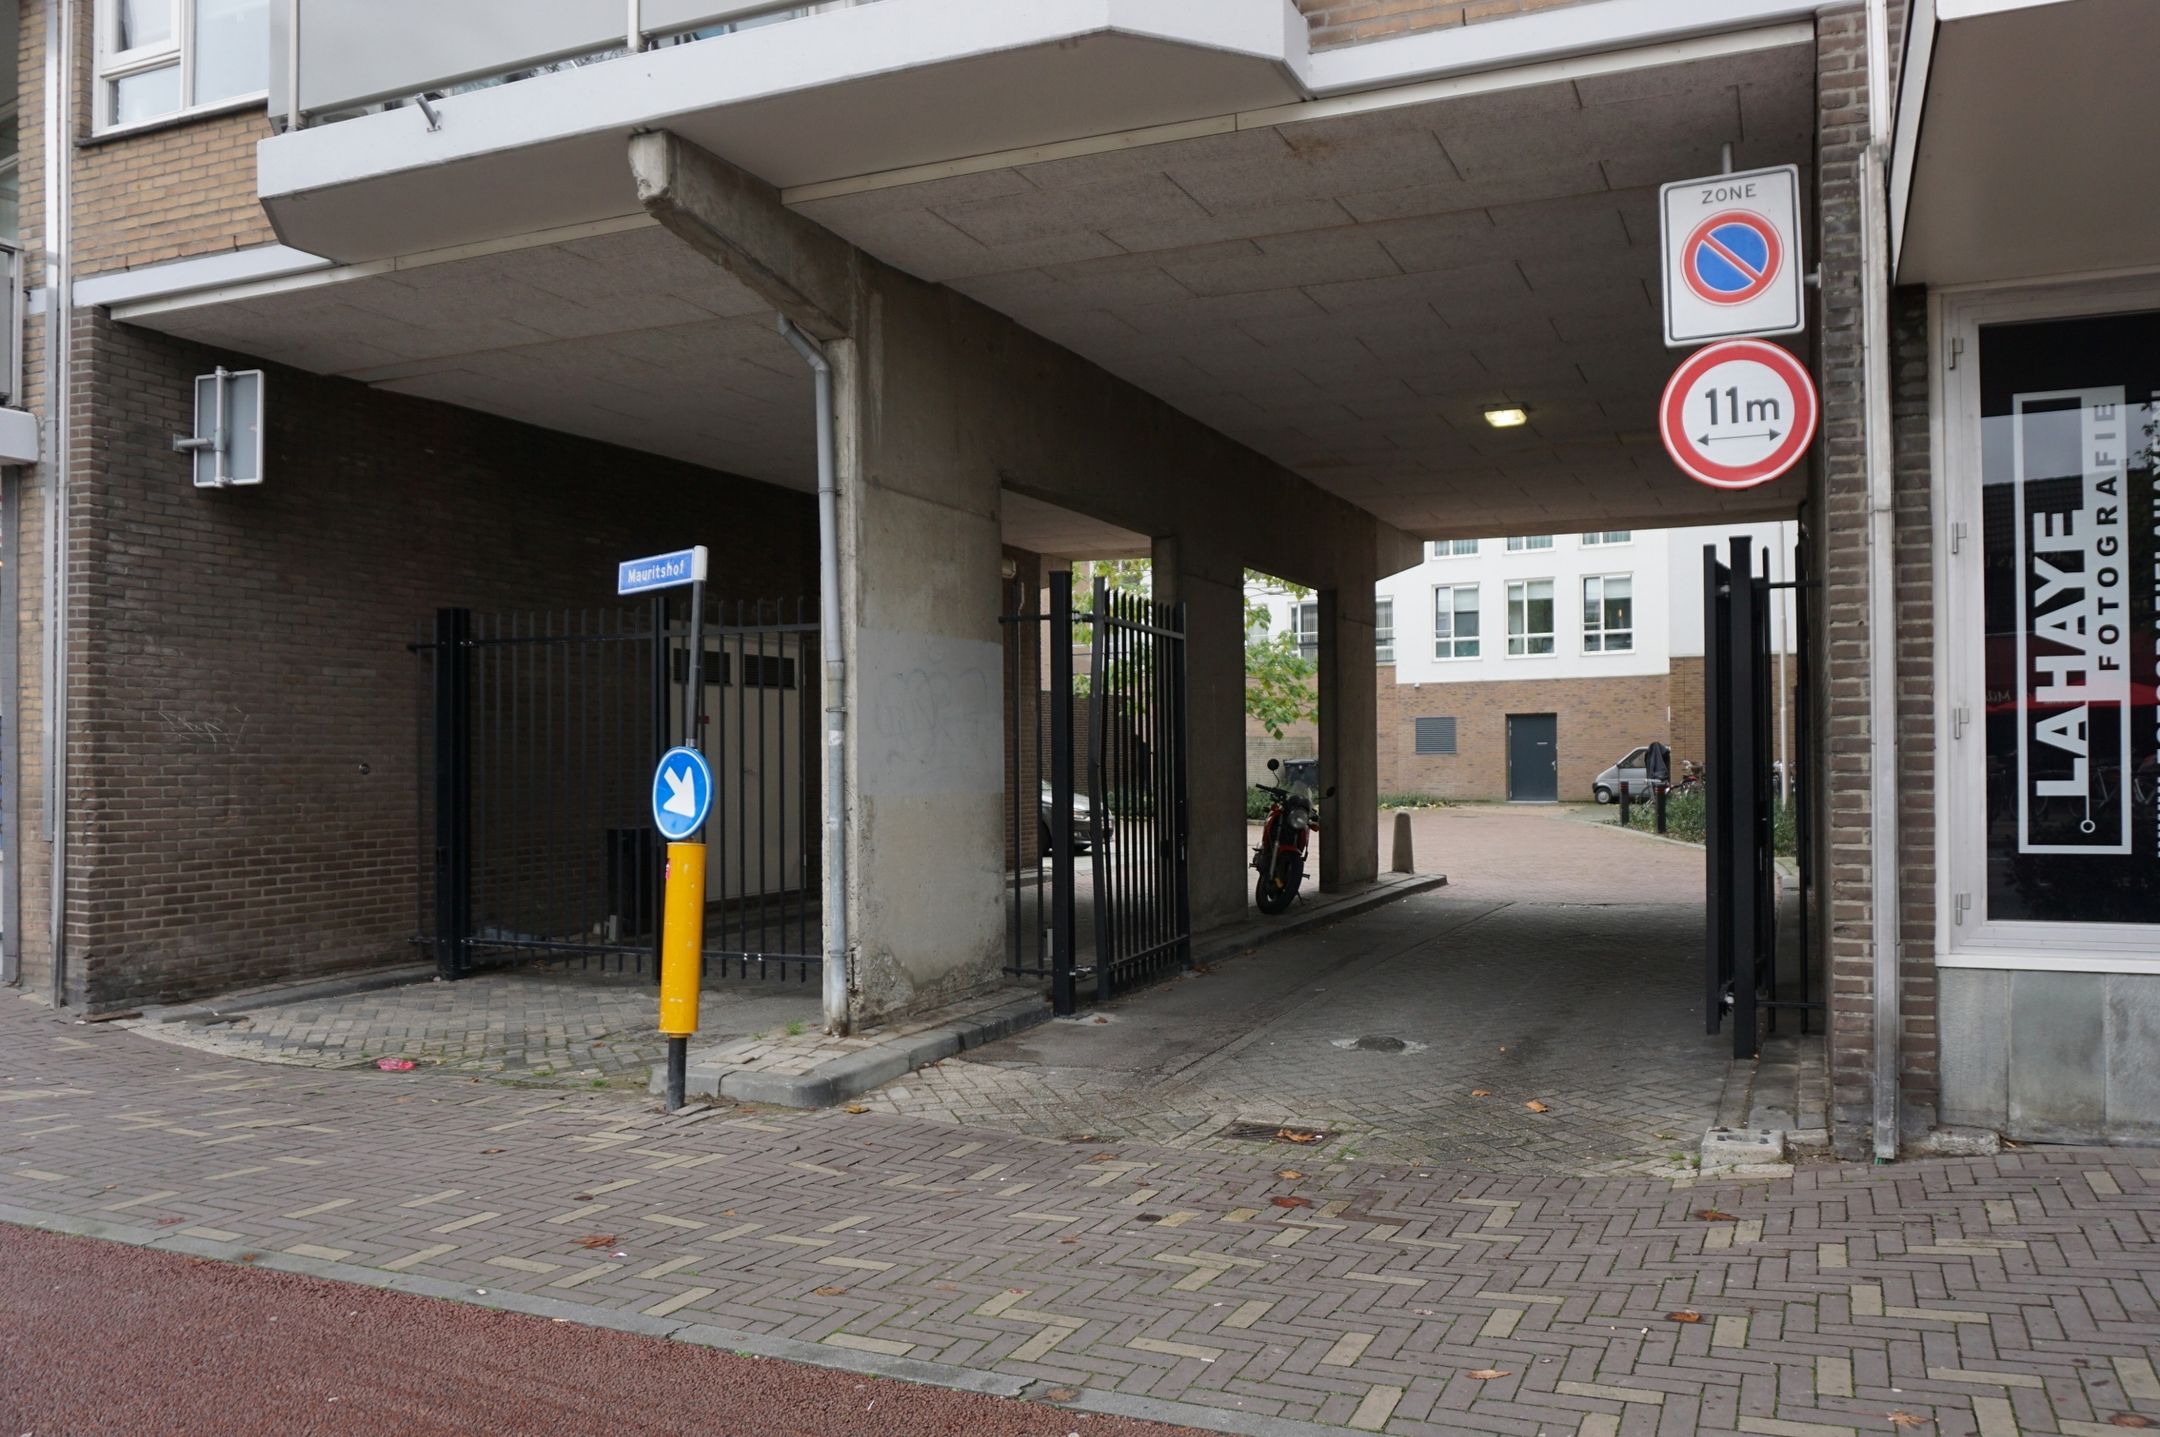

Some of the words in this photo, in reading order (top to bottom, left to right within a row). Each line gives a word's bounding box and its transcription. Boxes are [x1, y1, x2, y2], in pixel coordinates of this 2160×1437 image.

[1702, 183, 1757, 204] ZONE
[1705, 386, 1780, 425] 11m
[2093, 403, 2119, 670] FOTOGRAFIE
[628, 560, 684, 583] Mauritshof
[2033, 510, 2087, 796] LAHAYE
